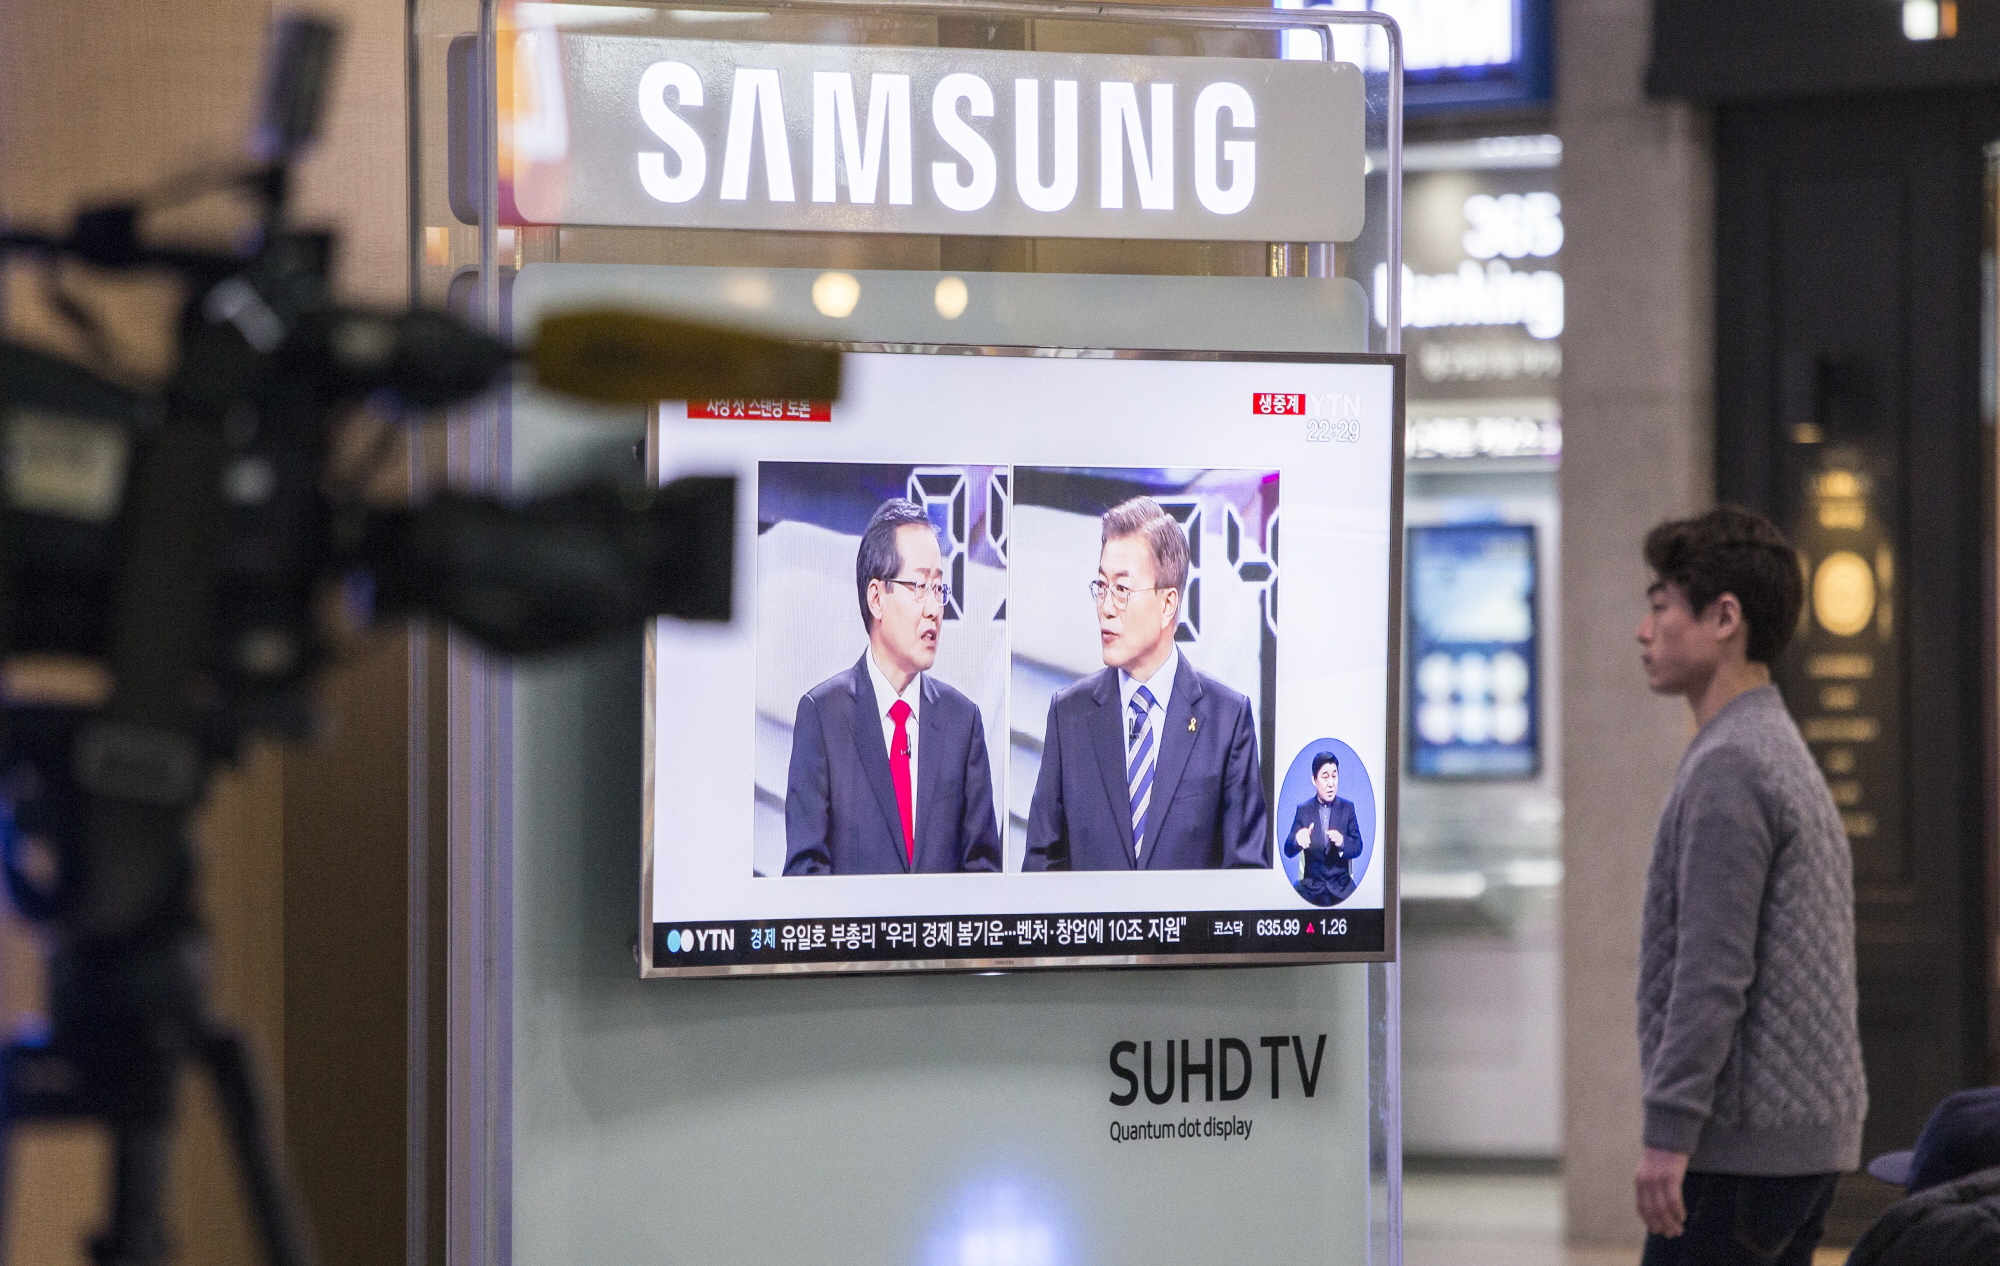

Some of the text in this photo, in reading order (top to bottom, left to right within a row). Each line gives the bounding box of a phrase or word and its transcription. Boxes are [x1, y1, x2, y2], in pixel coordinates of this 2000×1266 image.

[637, 60, 1257, 216] SAMSUNG
[1258, 393, 1299, 415] 생중계
[1308, 393, 1361, 418] YTN
[1306, 418, 1361, 444] 22:29
[695, 928, 735, 952] YTN
[750, 927, 776, 950] 경제
[780, 924, 827, 951] 유일호
[830, 922, 876, 950] 부총리
[921, 921, 953, 948] 경제
[1108, 918, 1144, 942] 10조
[1213, 918, 1347, 937] 코스닥 635.99 1.26
[1109, 1033, 1328, 1107] SUHD TV
[1109, 1114, 1254, 1143] Quantum dot display
